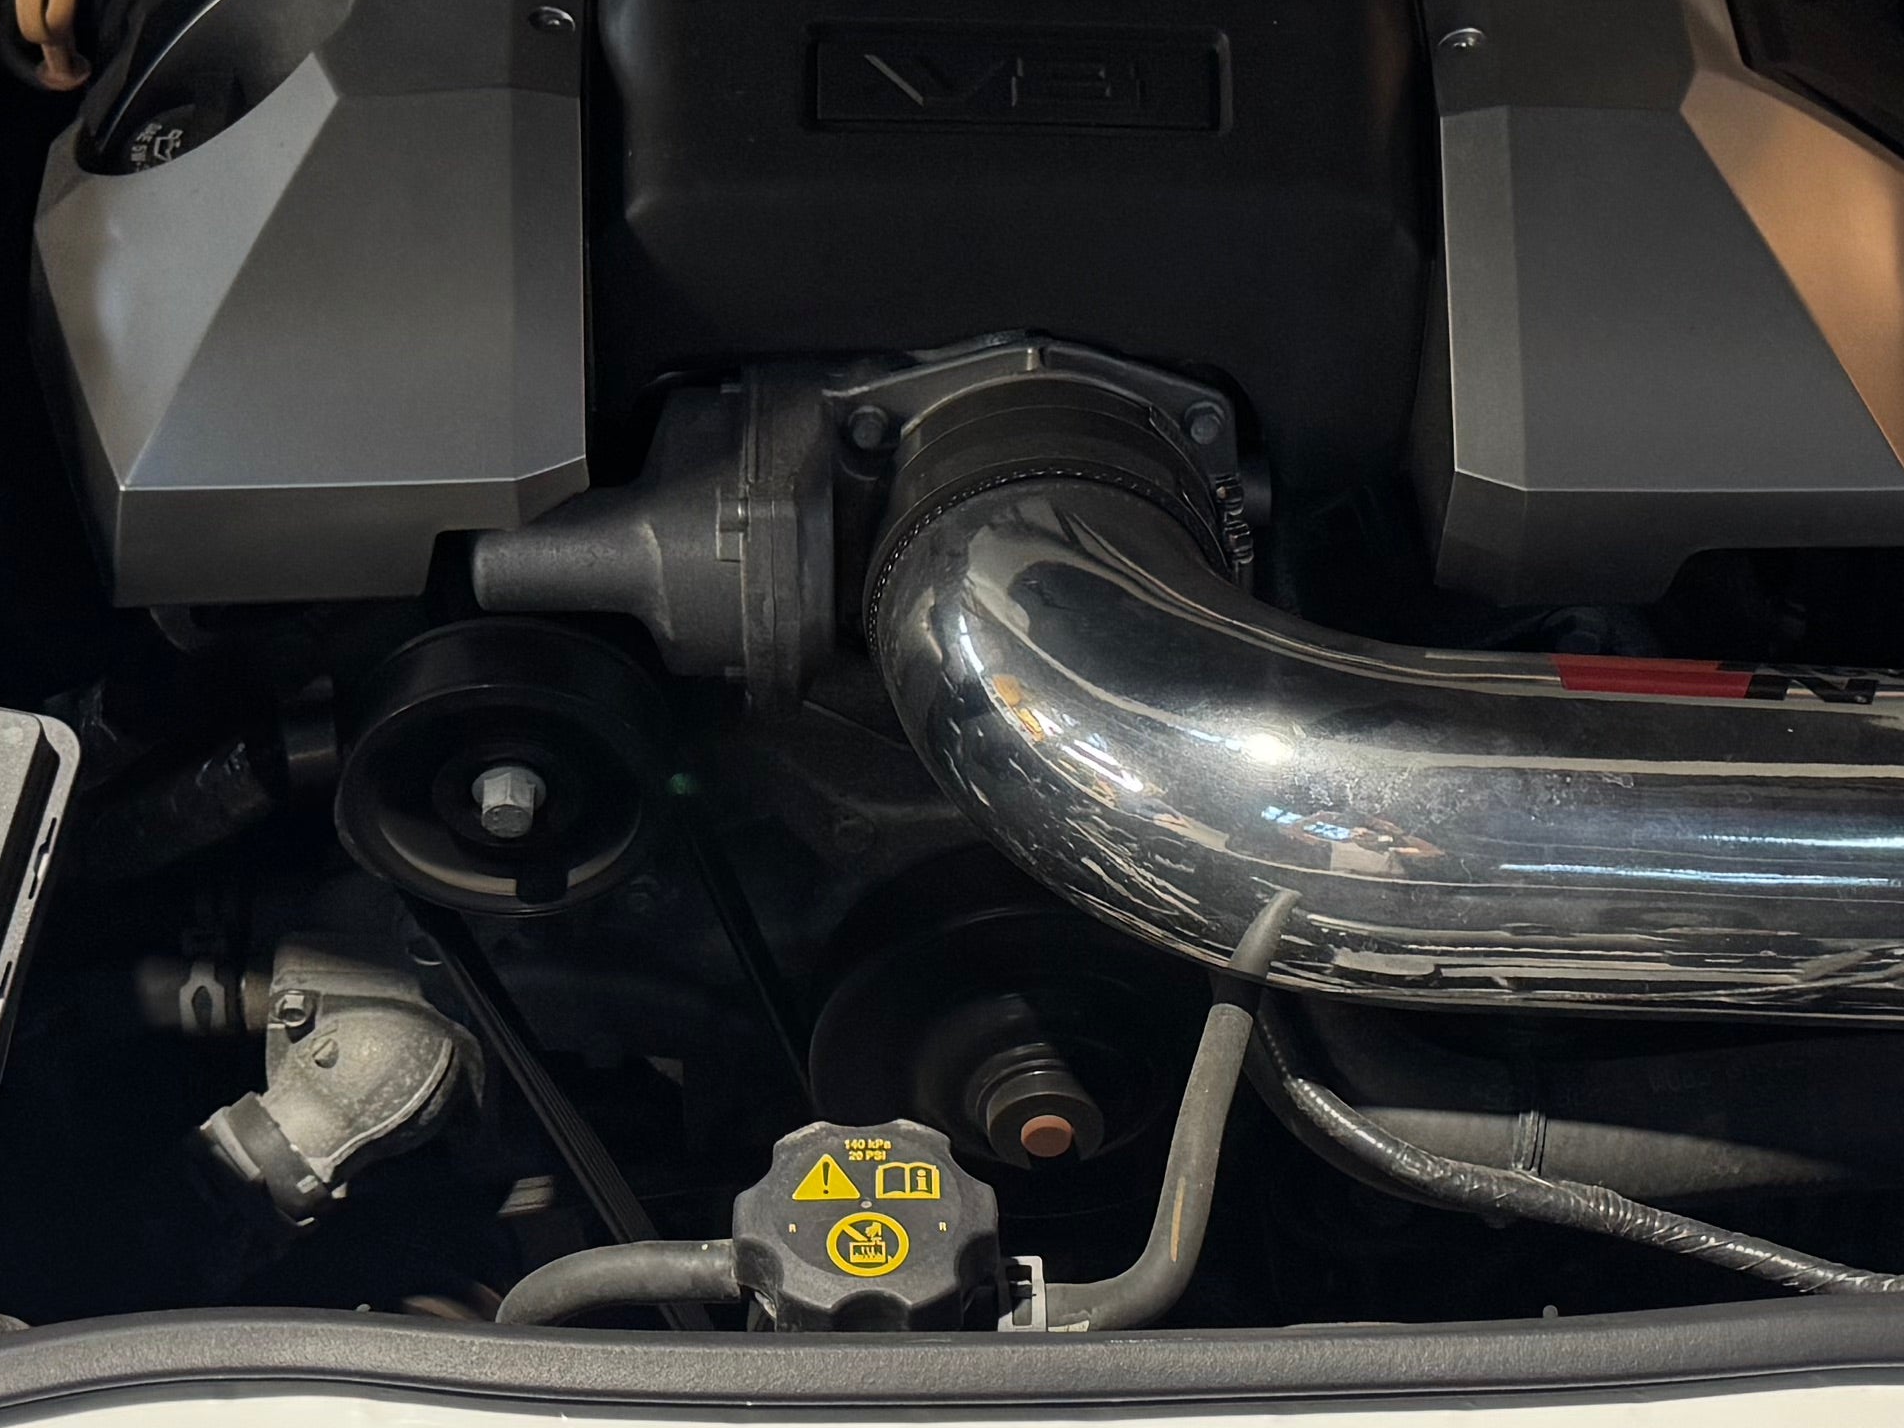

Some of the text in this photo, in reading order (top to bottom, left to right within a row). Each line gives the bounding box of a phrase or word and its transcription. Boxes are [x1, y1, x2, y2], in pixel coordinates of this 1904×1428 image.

[844, 1138, 892, 1150] 140 kPa
[848, 1150, 886, 1160] 20 PSI
